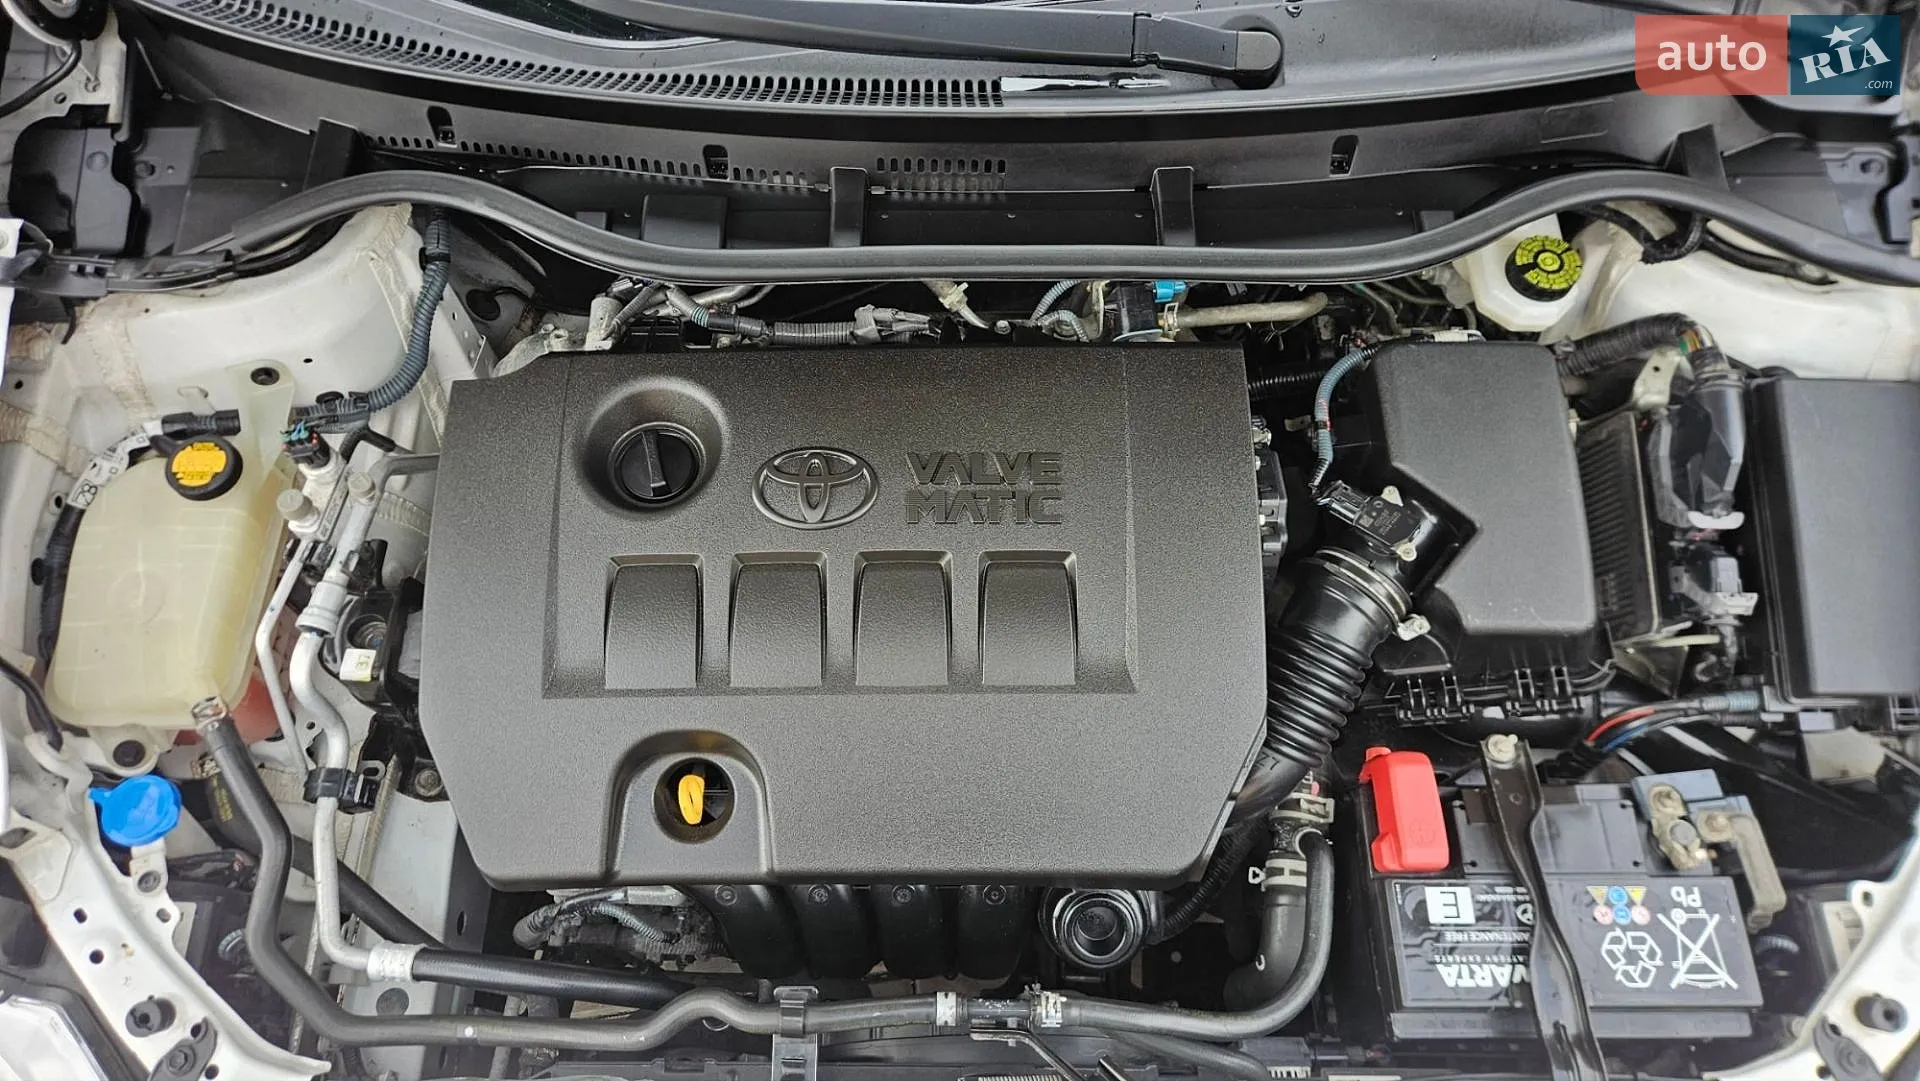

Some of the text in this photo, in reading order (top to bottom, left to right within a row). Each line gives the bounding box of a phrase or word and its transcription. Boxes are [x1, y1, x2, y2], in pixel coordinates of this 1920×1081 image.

[906, 451, 1062, 485] VALVE
[905, 490, 1062, 525] MATIC
[1440, 891, 1461, 919] E
[1670, 886, 1702, 907] Pb
[1469, 931, 1530, 942] AINTENANCE
[1486, 955, 1526, 963] ATTERY
[1435, 964, 1530, 988] VARTA
